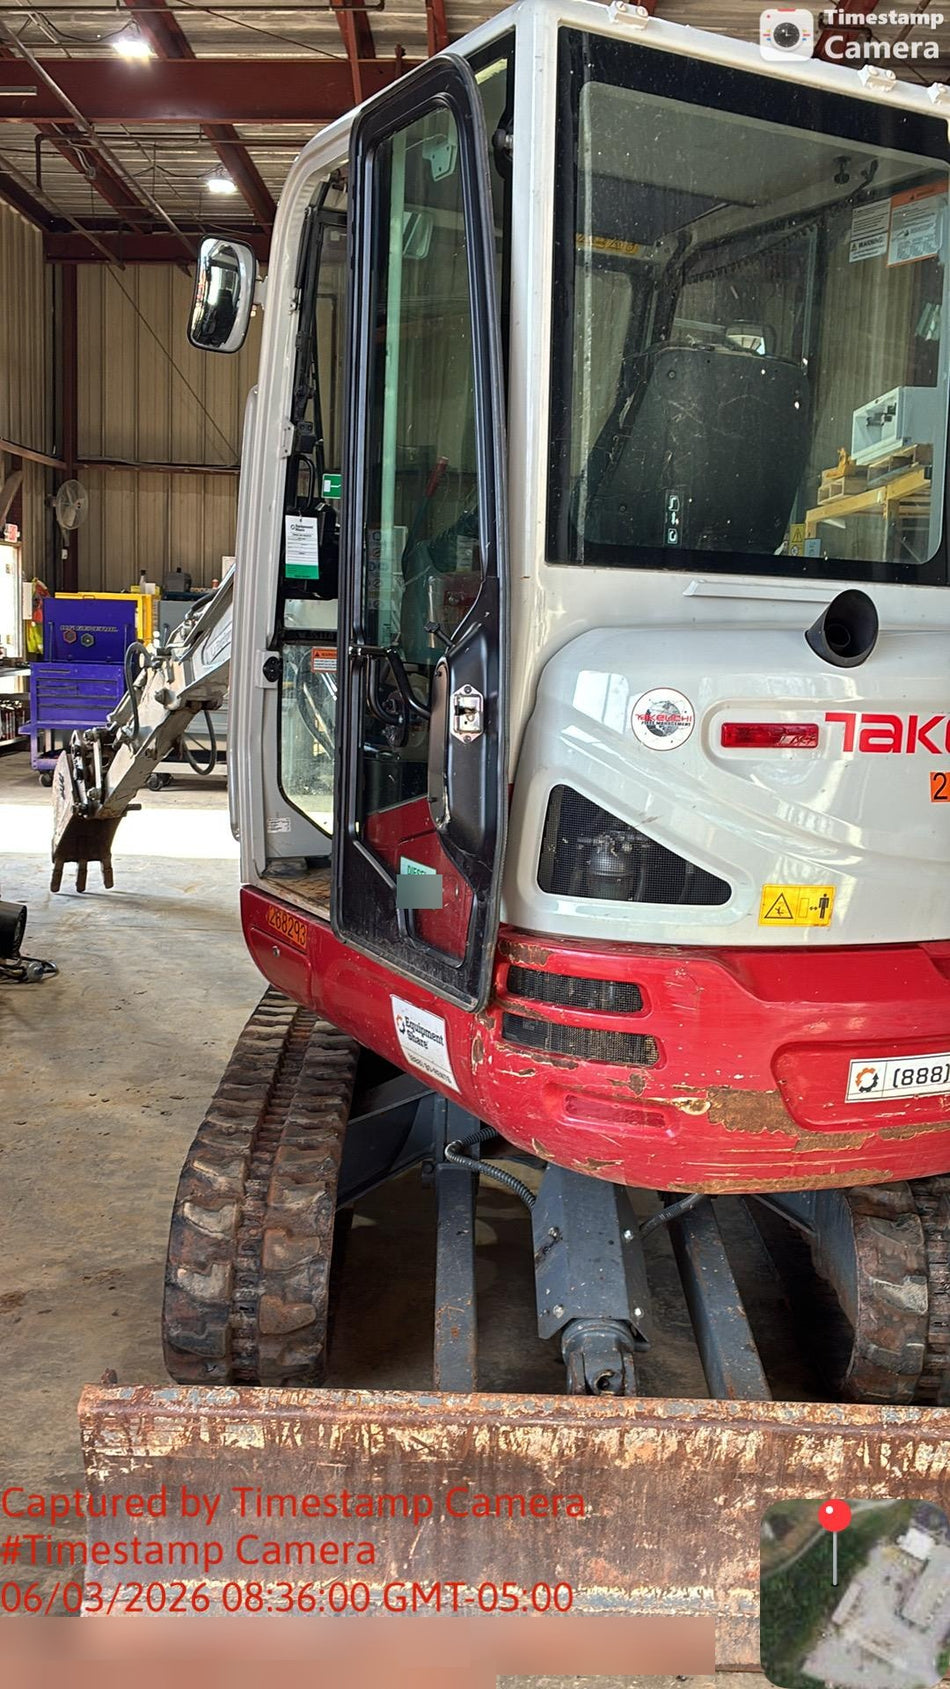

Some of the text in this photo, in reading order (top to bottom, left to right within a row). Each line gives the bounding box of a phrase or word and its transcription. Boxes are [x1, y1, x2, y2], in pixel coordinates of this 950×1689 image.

[269, 905, 306, 946] 268293
[404, 1015, 444, 1046] Equipment
[407, 1030, 429, 1049] Share
